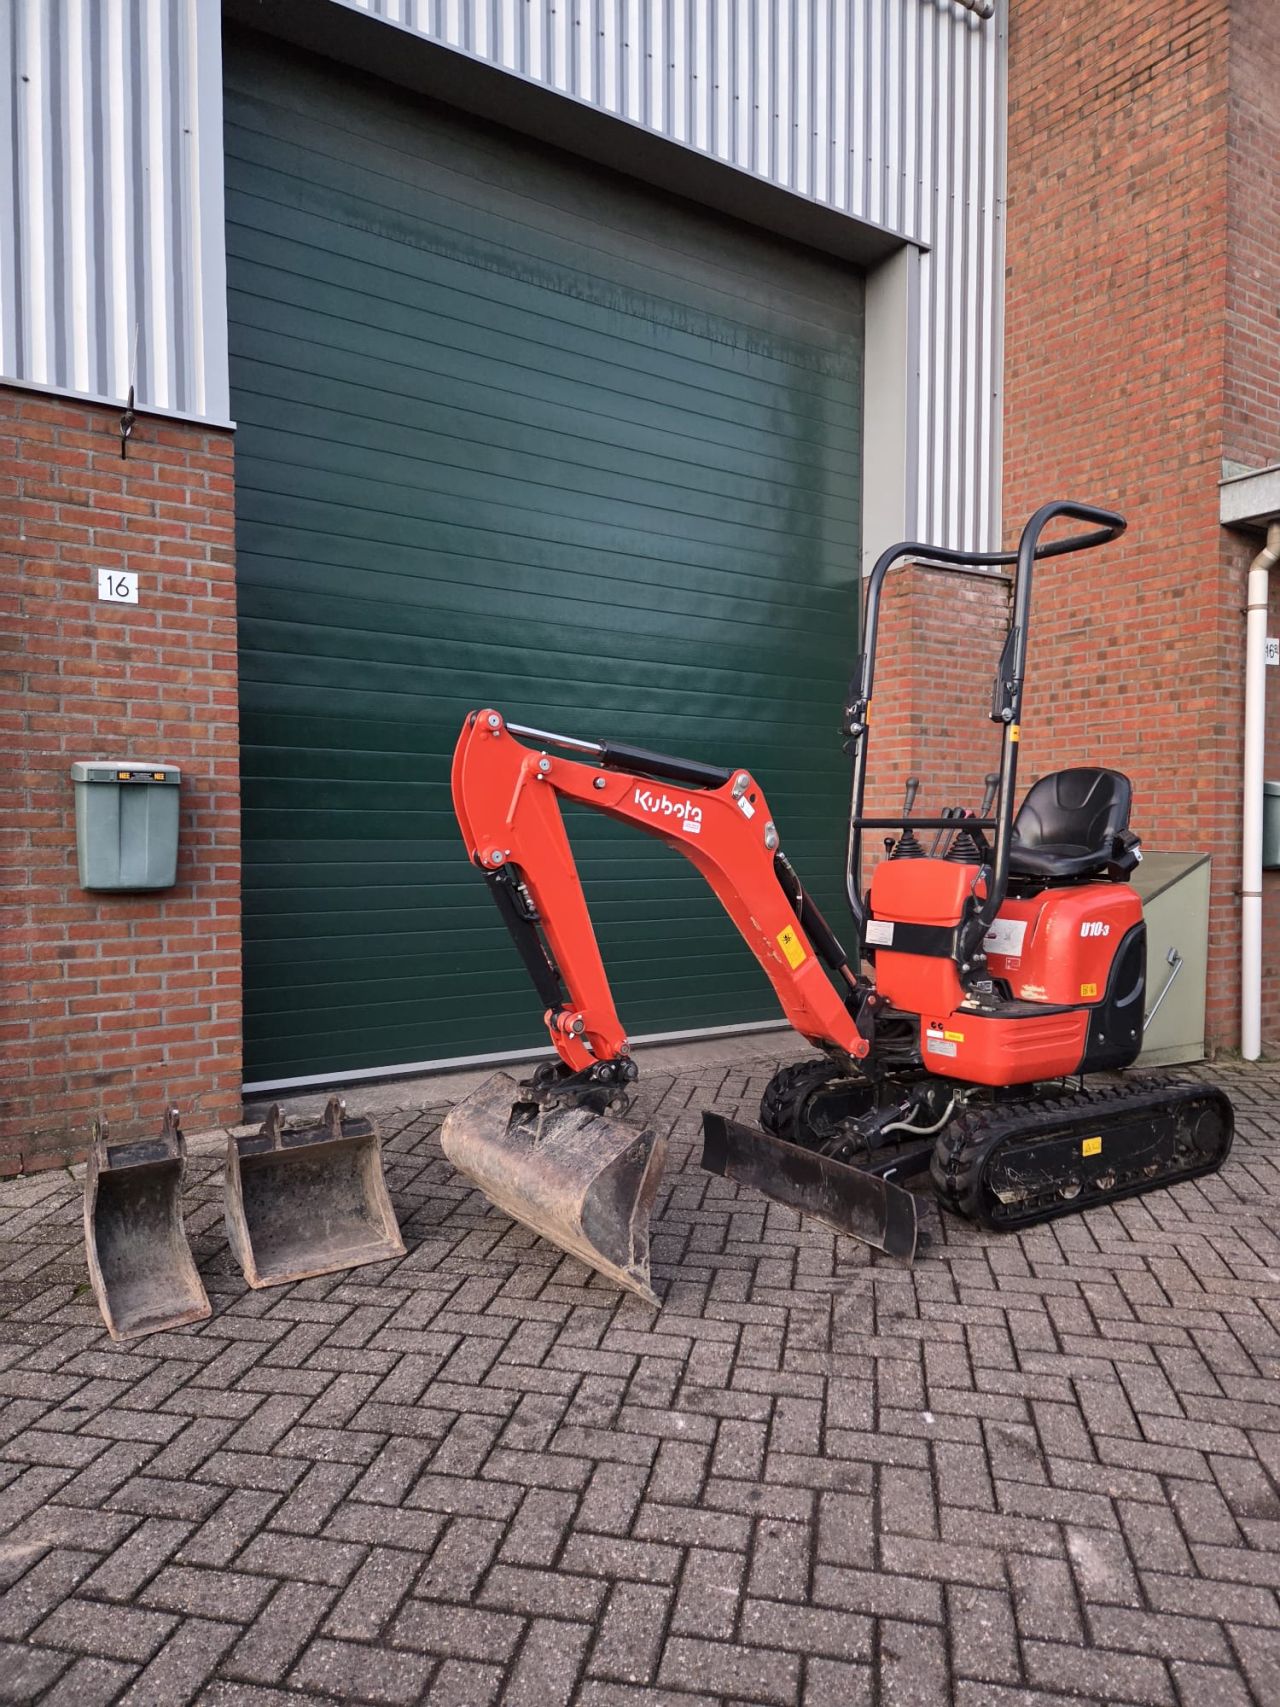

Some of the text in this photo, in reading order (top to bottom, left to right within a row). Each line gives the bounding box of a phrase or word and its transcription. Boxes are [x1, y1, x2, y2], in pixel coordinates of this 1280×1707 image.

[107, 575, 129, 597] 16
[634, 788, 703, 822] Kubota
[1080, 922, 1110, 937] U10-3
